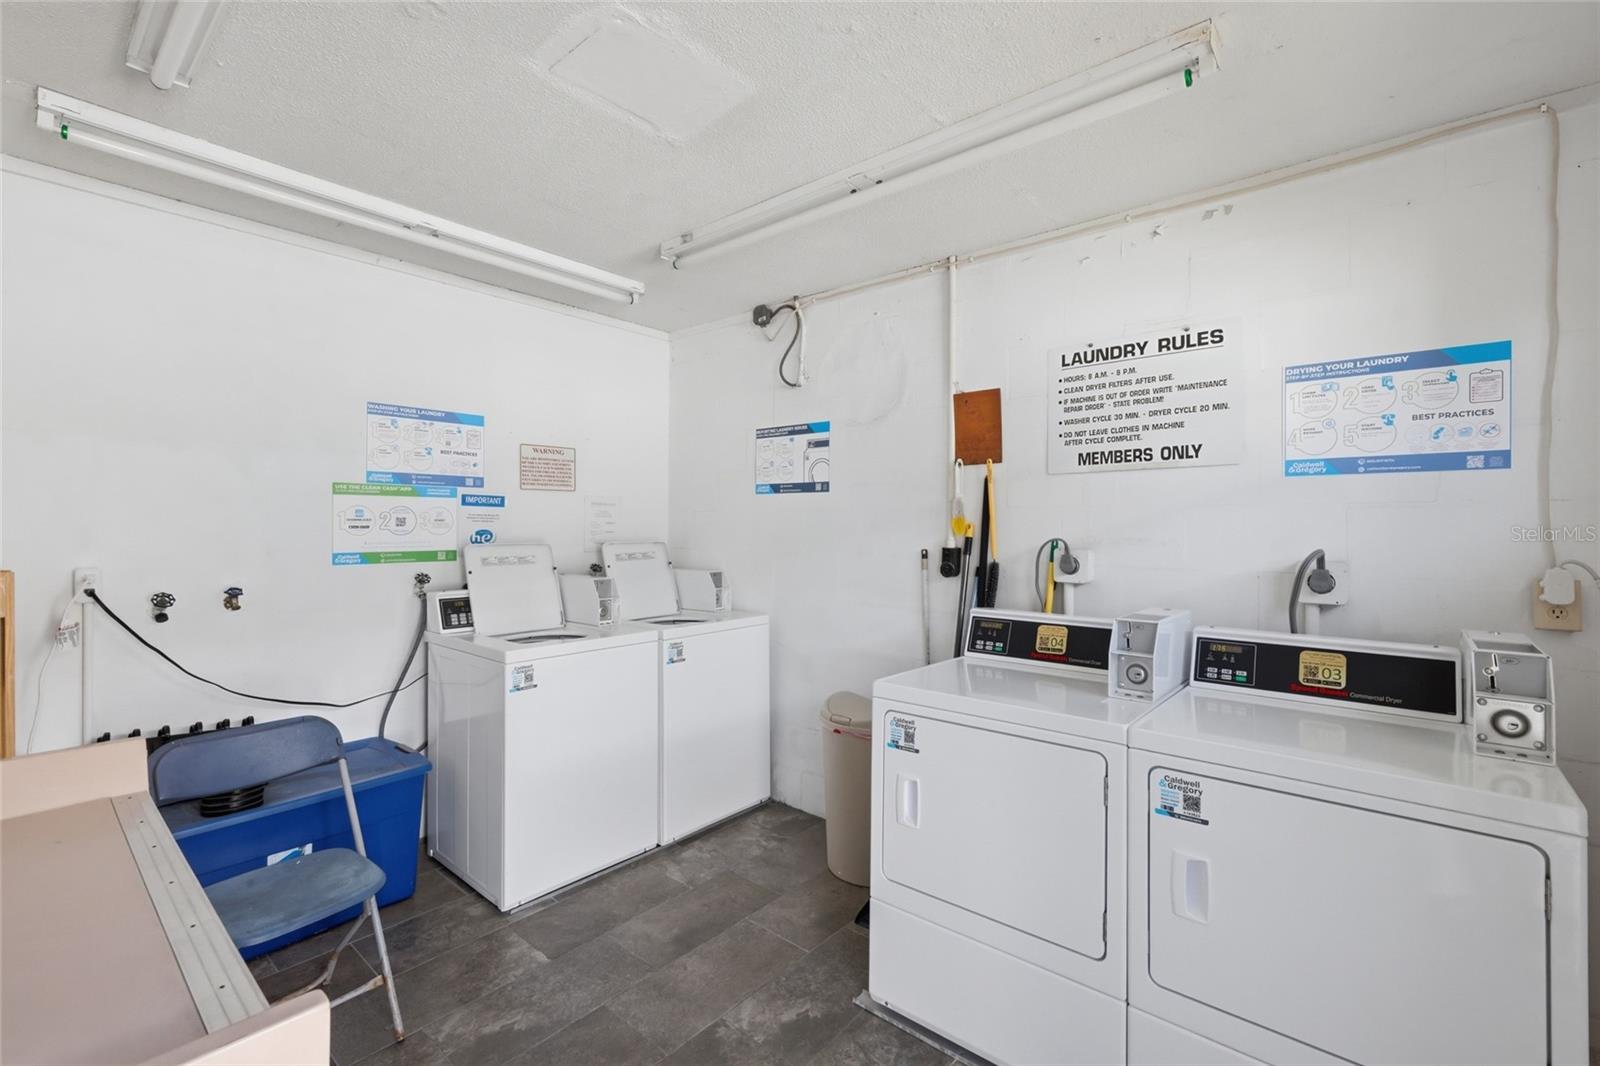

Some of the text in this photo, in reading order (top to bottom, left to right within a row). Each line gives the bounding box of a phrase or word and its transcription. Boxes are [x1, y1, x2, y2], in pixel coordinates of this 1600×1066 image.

[1062, 329, 1224, 367] LAUNDRY RULES
[1286, 355, 1410, 376] DRYING YOUR LAUNDRY
[1064, 374, 1086, 383] HOURS:
[1095, 371, 1108, 379] A.M.
[1123, 367, 1138, 375] P.M.
[1064, 373, 1175, 394] CLEAN DRYER FILTERS AFTER USE.
[1070, 395, 1096, 404] MACHINE
[1130, 388, 1151, 398] ORDER
[1152, 386, 1173, 395] WRITE
[1064, 405, 1083, 413] REPAIR
[1113, 400, 1131, 408] STATE
[1064, 417, 1090, 426] WASHER
[1092, 414, 1112, 423] CYCLE
[1114, 413, 1123, 421] 30
[1125, 411, 1140, 420] MIN.
[1148, 408, 1172, 417] DRYER
[1174, 405, 1198, 415] CYCLE
[1199, 404, 1210, 412] 20
[1212, 402, 1230, 411] MIN.
[1412, 408, 1495, 421] BEST PRACTICES
[1064, 431, 1073, 439] DO
[1074, 430, 1087, 438] NOT
[1089, 428, 1109, 436] LEAVE
[1110, 425, 1140, 434] CLOTHES
[1152, 421, 1185, 431] MACHINE
[1064, 434, 1143, 446] AFTER CYCLE COMPLETE.
[532, 447, 565, 456] WARNING
[1078, 444, 1203, 466] MEMBERS ONLY
[465, 495, 502, 505] IMPORTANT
[1050, 637, 1064, 648] 04
[1321, 667, 1342, 681] 03
[1350, 691, 1402, 704] Commercial Dryer
[1164, 775, 1201, 789] Caldwell
[1167, 782, 1203, 797] Gregory
